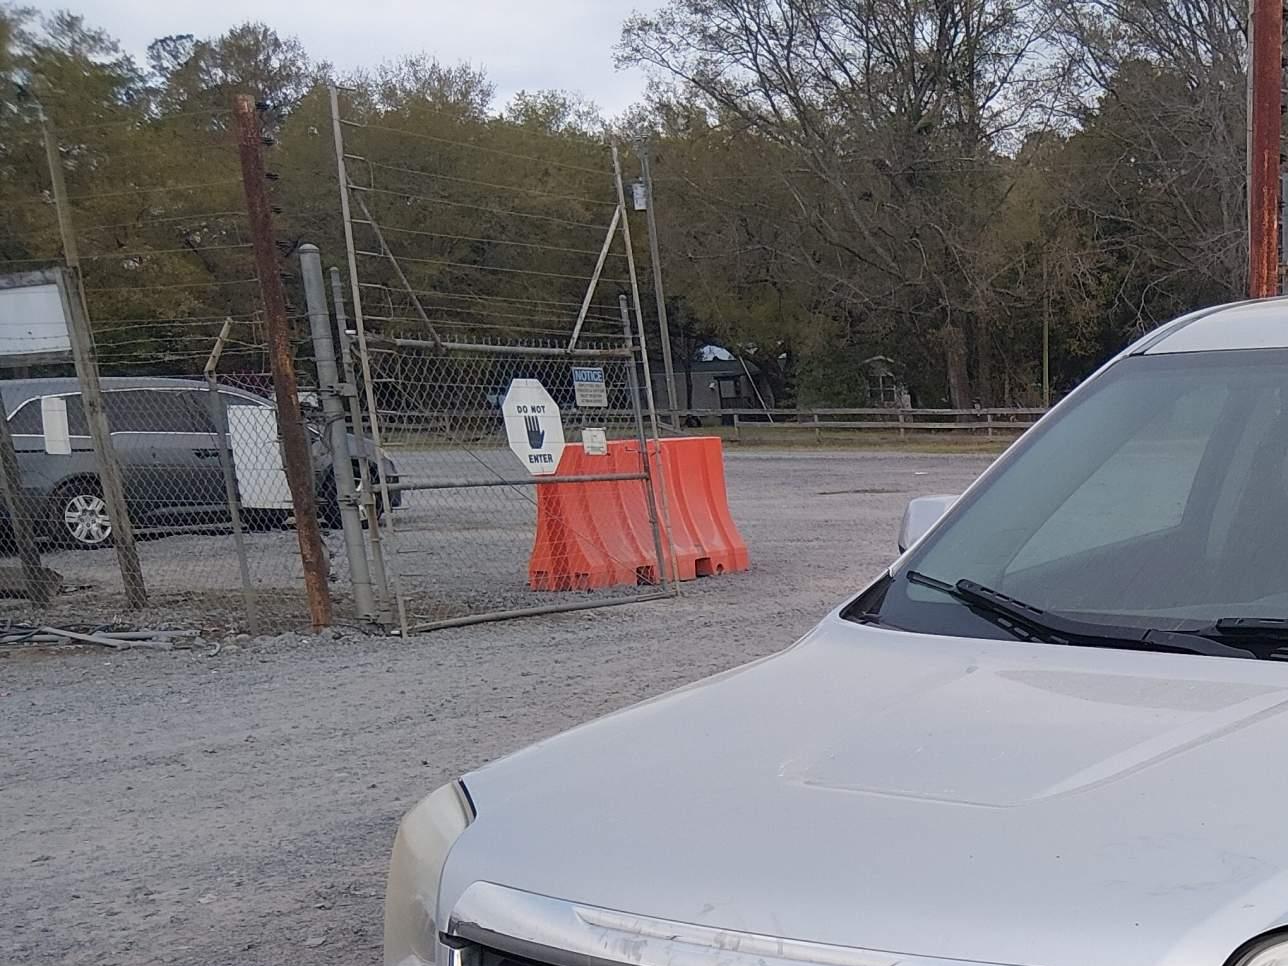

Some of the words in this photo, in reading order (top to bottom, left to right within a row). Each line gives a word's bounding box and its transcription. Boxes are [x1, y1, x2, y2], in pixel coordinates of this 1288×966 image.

[575, 370, 603, 381] NOTICE
[517, 405, 528, 413] DO
[531, 405, 546, 413] NOT
[528, 454, 553, 464] ENTER
